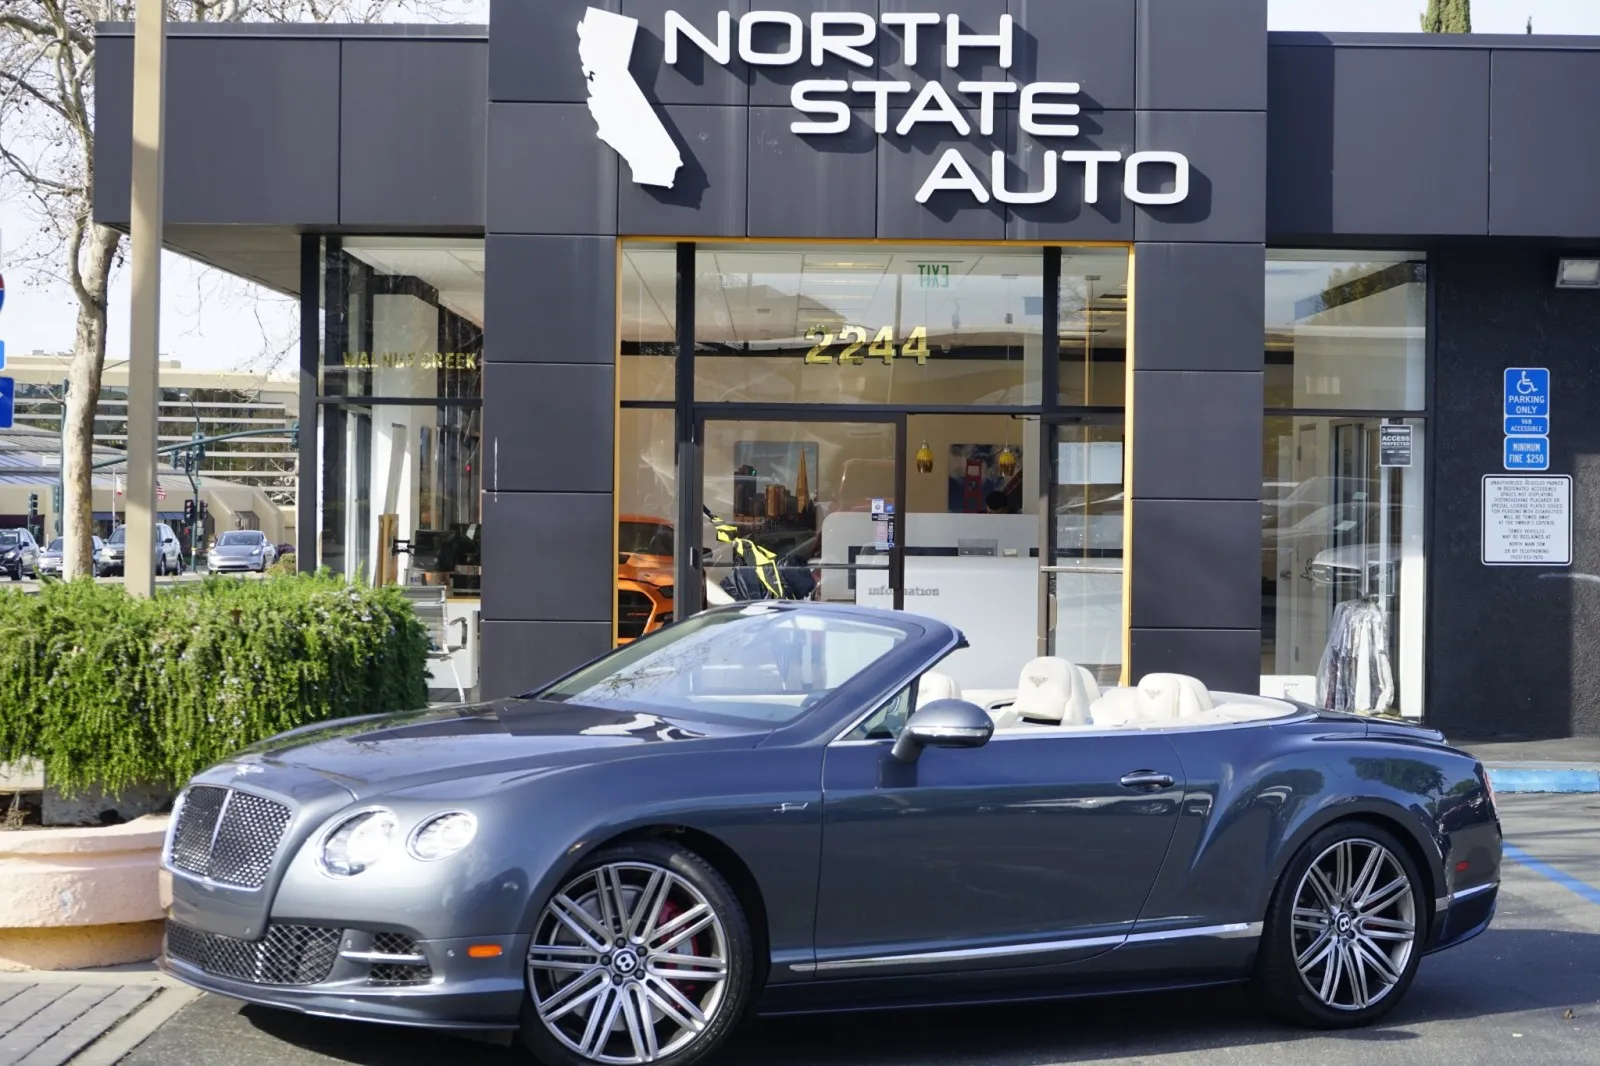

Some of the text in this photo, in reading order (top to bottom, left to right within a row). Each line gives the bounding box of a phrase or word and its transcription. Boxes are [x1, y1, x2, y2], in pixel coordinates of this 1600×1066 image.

[664, 8, 1013, 68] NORTH
[790, 79, 1080, 136] STATE
[914, 148, 1190, 205] AUTO
[804, 324, 931, 365] 2244
[420, 352, 477, 369] CREEK
[1508, 395, 1545, 404] PARKING
[1515, 405, 1538, 414] ONLY
[1512, 443, 1541, 452] MINIMUM
[1508, 453, 1545, 464] FINE $250
[868, 585, 940, 597] infoation
